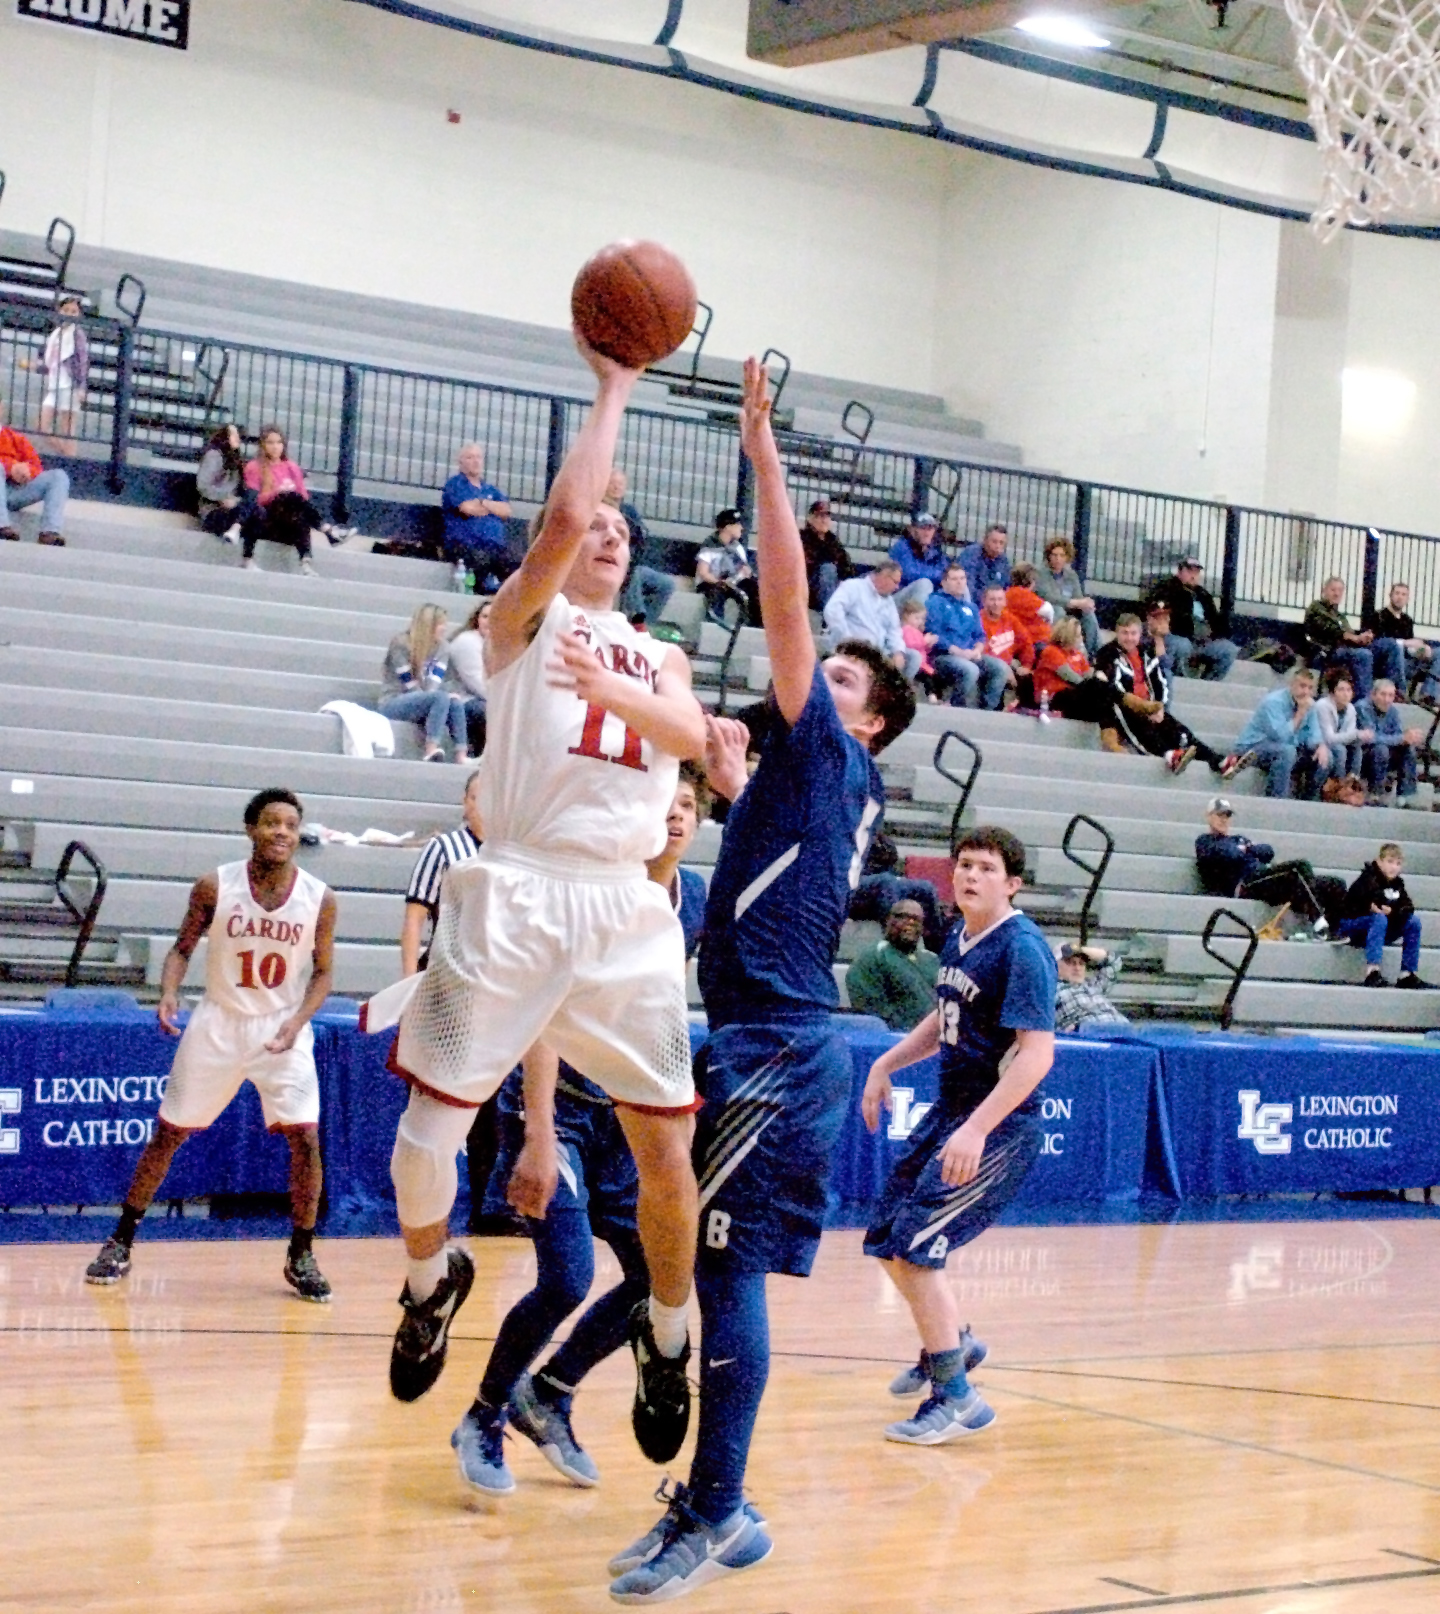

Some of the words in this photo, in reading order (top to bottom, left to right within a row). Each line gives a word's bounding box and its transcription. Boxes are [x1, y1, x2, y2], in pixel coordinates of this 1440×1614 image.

[226, 914, 304, 946] CARDS
[236, 949, 287, 990] 10
[34, 1075, 170, 1103] LEXINGT
[1299, 1095, 1398, 1116] LEXINGTON
[43, 1118, 154, 1147] CATHOL
[1238, 1089, 1293, 1155] LC
[1304, 1127, 1393, 1149] CATHOLIC
[706, 1209, 732, 1250] B
[928, 1234, 949, 1259] B
